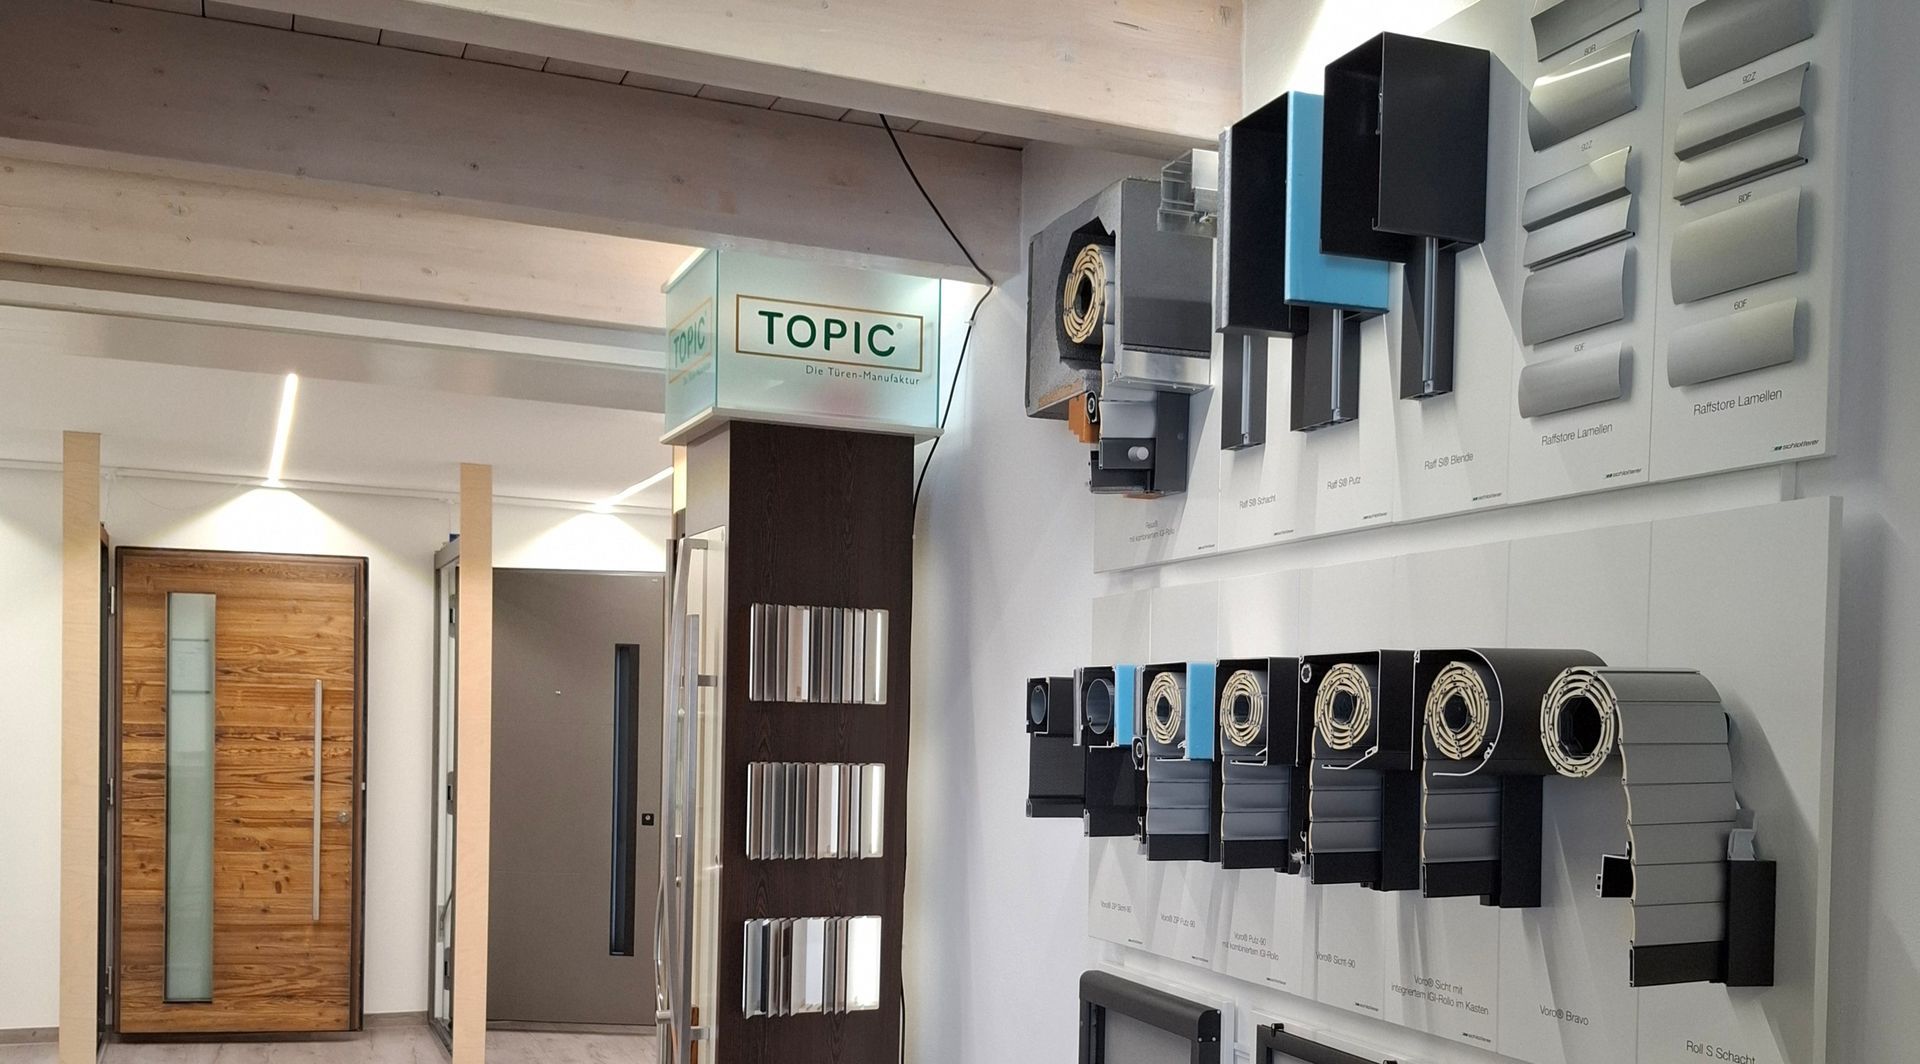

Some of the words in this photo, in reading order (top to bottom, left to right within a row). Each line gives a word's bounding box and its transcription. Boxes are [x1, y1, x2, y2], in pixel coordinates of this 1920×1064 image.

[1733, 298, 1748, 310] 60F
[673, 316, 705, 368] TOPIC
[758, 310, 896, 357] TOPIC
[805, 364, 824, 376] Die
[828, 367, 920, 386] Türen-Manufaktur
[1693, 398, 1735, 416] Raffstore
[1738, 389, 1783, 407] Lamellen
[1541, 431, 1576, 446] Raffstore
[1577, 423, 1613, 439] Lamellen
[1424, 458, 1437, 470] Raff
[1450, 453, 1474, 465] Blende
[1434, 979, 1451, 992] Sicht
[1452, 984, 1463, 995] mit
[1455, 1000, 1464, 1008] im
[1465, 1001, 1489, 1015] Kasten
[1565, 1010, 1589, 1026] Bravo
[1686, 1039, 1704, 1055] Roll
[1706, 1045, 1713, 1058] S
